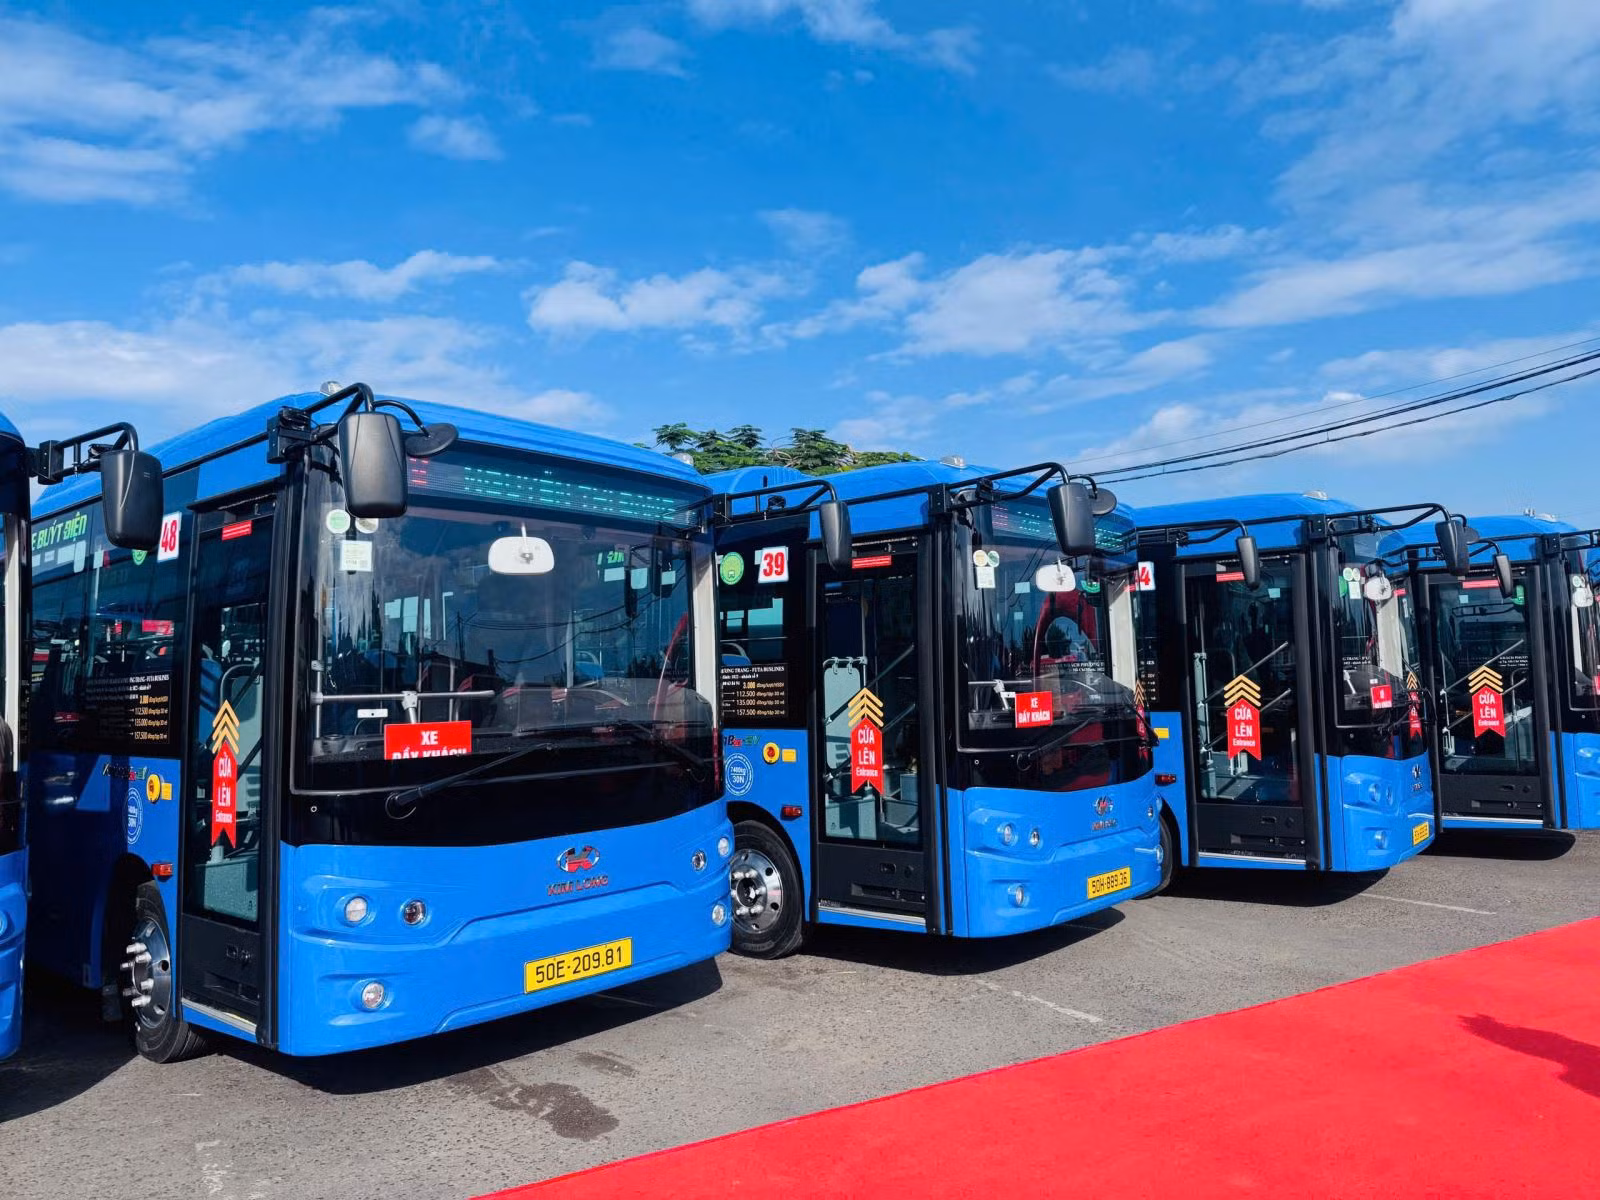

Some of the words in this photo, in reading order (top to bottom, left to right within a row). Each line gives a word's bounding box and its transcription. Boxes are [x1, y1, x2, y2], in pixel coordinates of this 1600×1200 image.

[36, 520, 63, 549] BUÝT
[63, 511, 87, 541] ĐIỆN
[161, 519, 177, 553] 48
[762, 551, 785, 577] 39
[1478, 690, 1496, 704] CỬA
[1234, 704, 1253, 720] CỬA
[1480, 705, 1497, 719] LÊN
[421, 730, 439, 746] XE
[857, 724, 875, 744] CỬA
[1235, 722, 1253, 737] LÊN
[218, 751, 232, 777] CỬA
[858, 746, 876, 765] LÊN
[218, 782, 231, 807] LÊN
[547, 880, 574, 896] KIM
[575, 875, 609, 891] LONG
